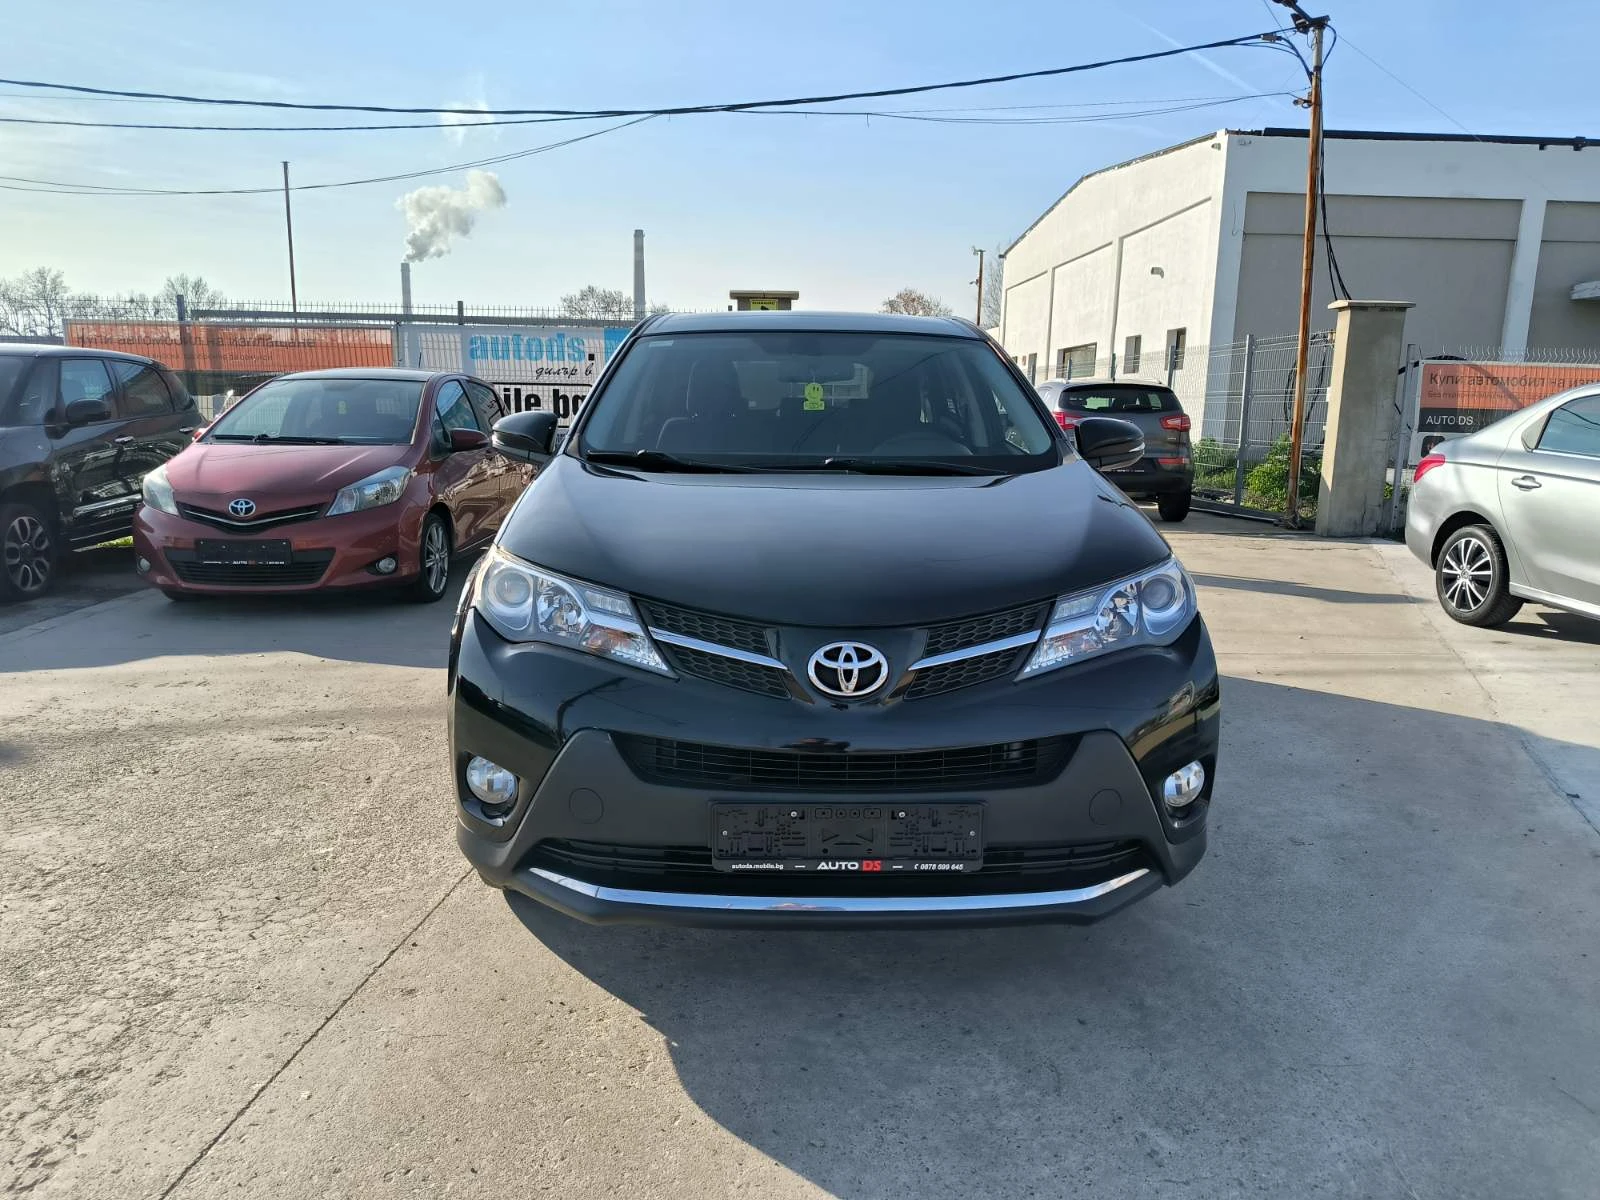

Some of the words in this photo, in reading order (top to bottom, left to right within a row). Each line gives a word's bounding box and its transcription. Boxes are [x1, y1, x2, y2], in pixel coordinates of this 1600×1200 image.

[1430, 373, 1460, 386] Купи
[1467, 374, 1545, 387] автомобил
[1426, 415, 1456, 425] AUTO
[1458, 415, 1474, 425] DS
[816, 861, 859, 870] AUTO
[862, 860, 881, 871] DS
